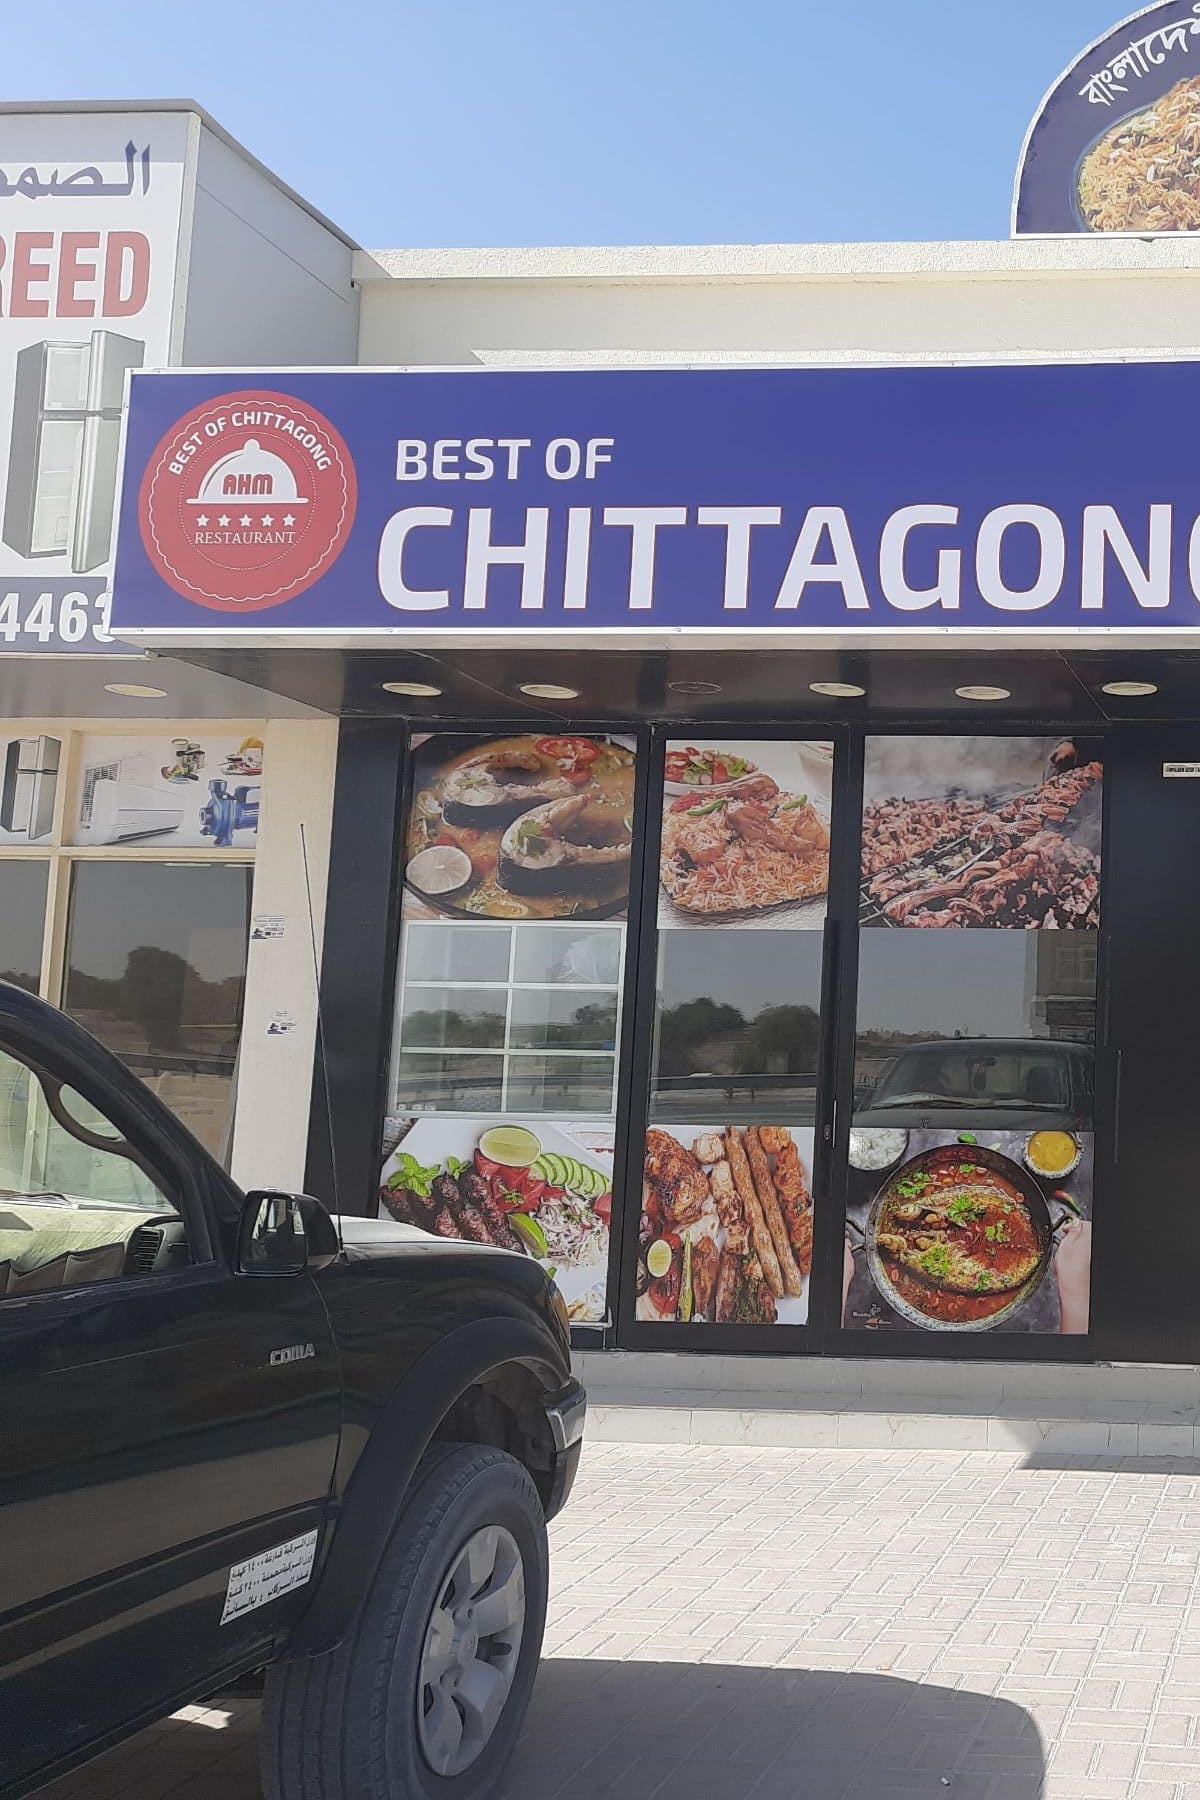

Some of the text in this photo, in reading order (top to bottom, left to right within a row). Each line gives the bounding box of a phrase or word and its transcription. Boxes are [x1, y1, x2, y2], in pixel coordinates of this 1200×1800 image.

[0, 230, 151, 318] EED
[167, 410, 333, 476] BEST OF CHITTAGONG
[395, 437, 616, 482] BEST OF
[222, 473, 274, 496] AHM
[193, 530, 297, 545] RESTAURANT
